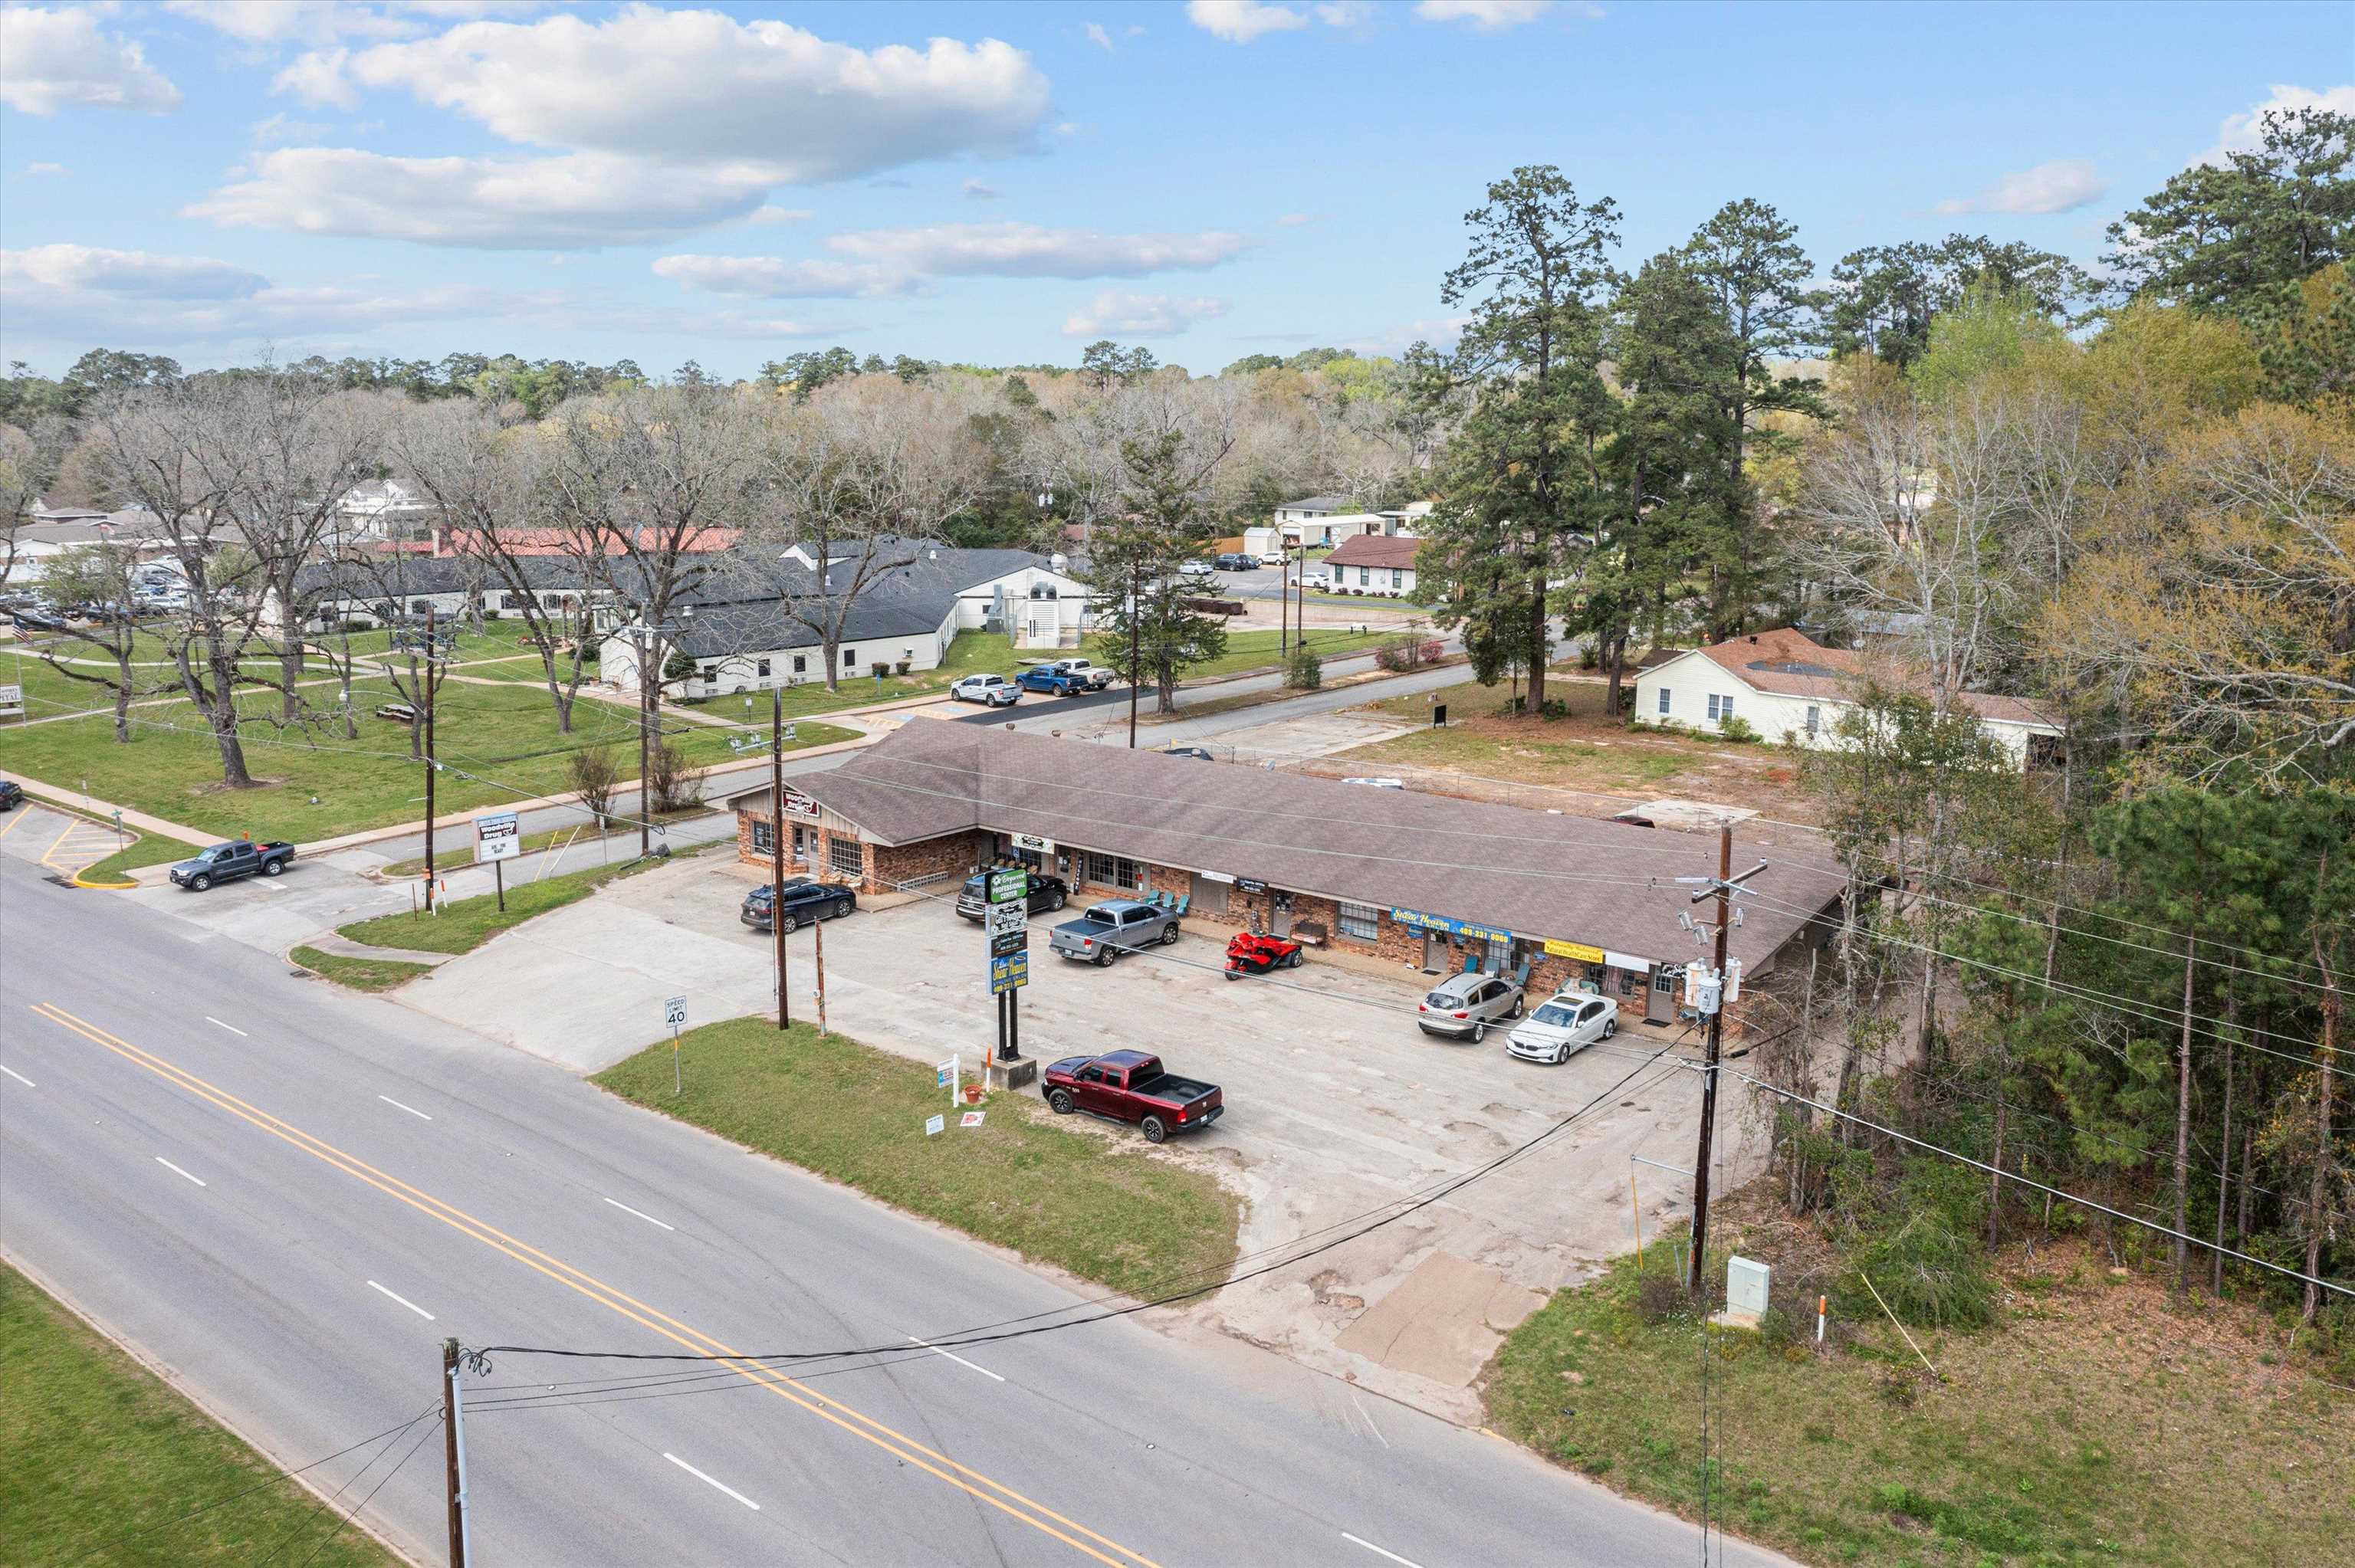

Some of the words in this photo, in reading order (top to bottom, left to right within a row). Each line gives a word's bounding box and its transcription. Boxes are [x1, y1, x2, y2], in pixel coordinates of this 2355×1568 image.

[481, 822, 515, 833] Woodville
[992, 881, 1026, 894] PROFESSIONAL
[1000, 890, 1017, 900] CENTER
[993, 963, 1007, 981] Shear
[1009, 956, 1026, 976] Heaven
[668, 999, 685, 1008] SPEED
[668, 1012, 685, 1023] 40
